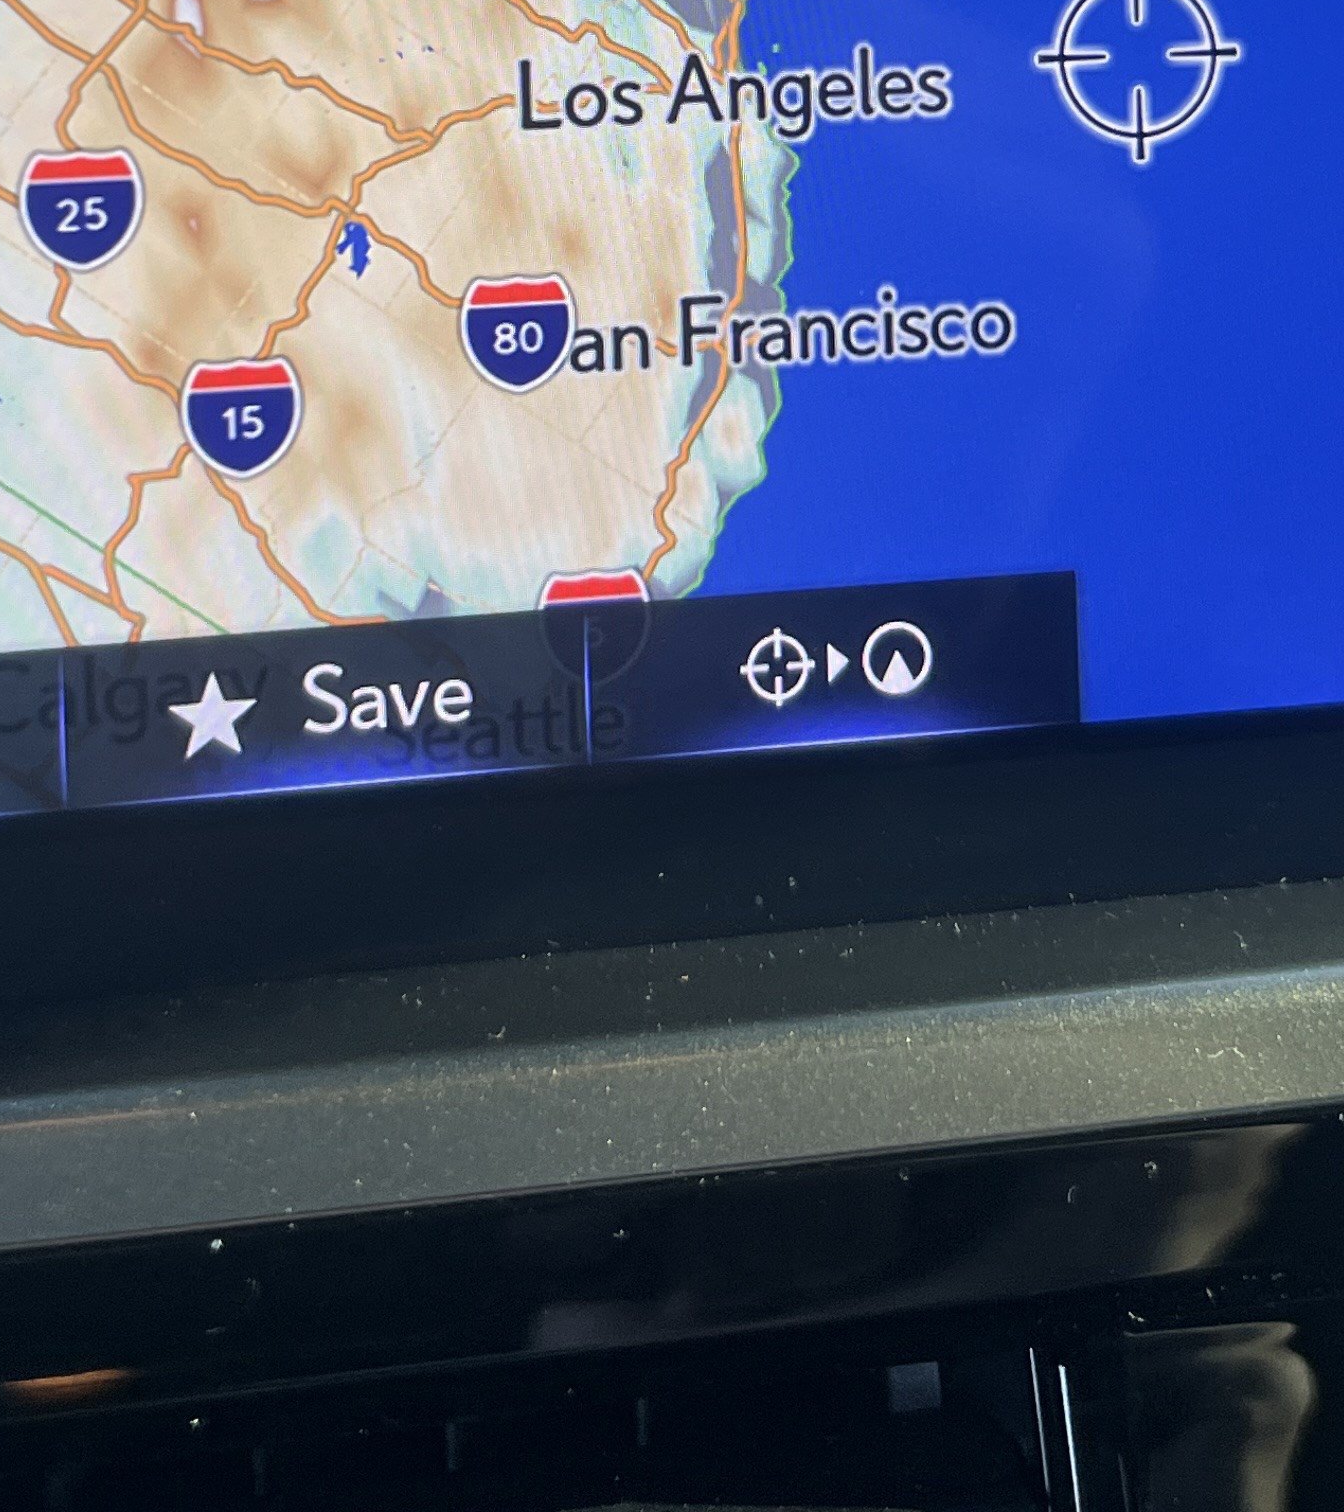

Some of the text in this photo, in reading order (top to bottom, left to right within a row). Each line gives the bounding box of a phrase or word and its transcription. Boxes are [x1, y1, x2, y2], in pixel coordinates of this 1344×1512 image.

[519, 47, 950, 138] Los Angeles
[56, 198, 108, 232] 25
[492, 320, 544, 356] 80
[570, 289, 1013, 373] an Francisco
[223, 406, 264, 441] 15
[302, 662, 474, 734] Save
